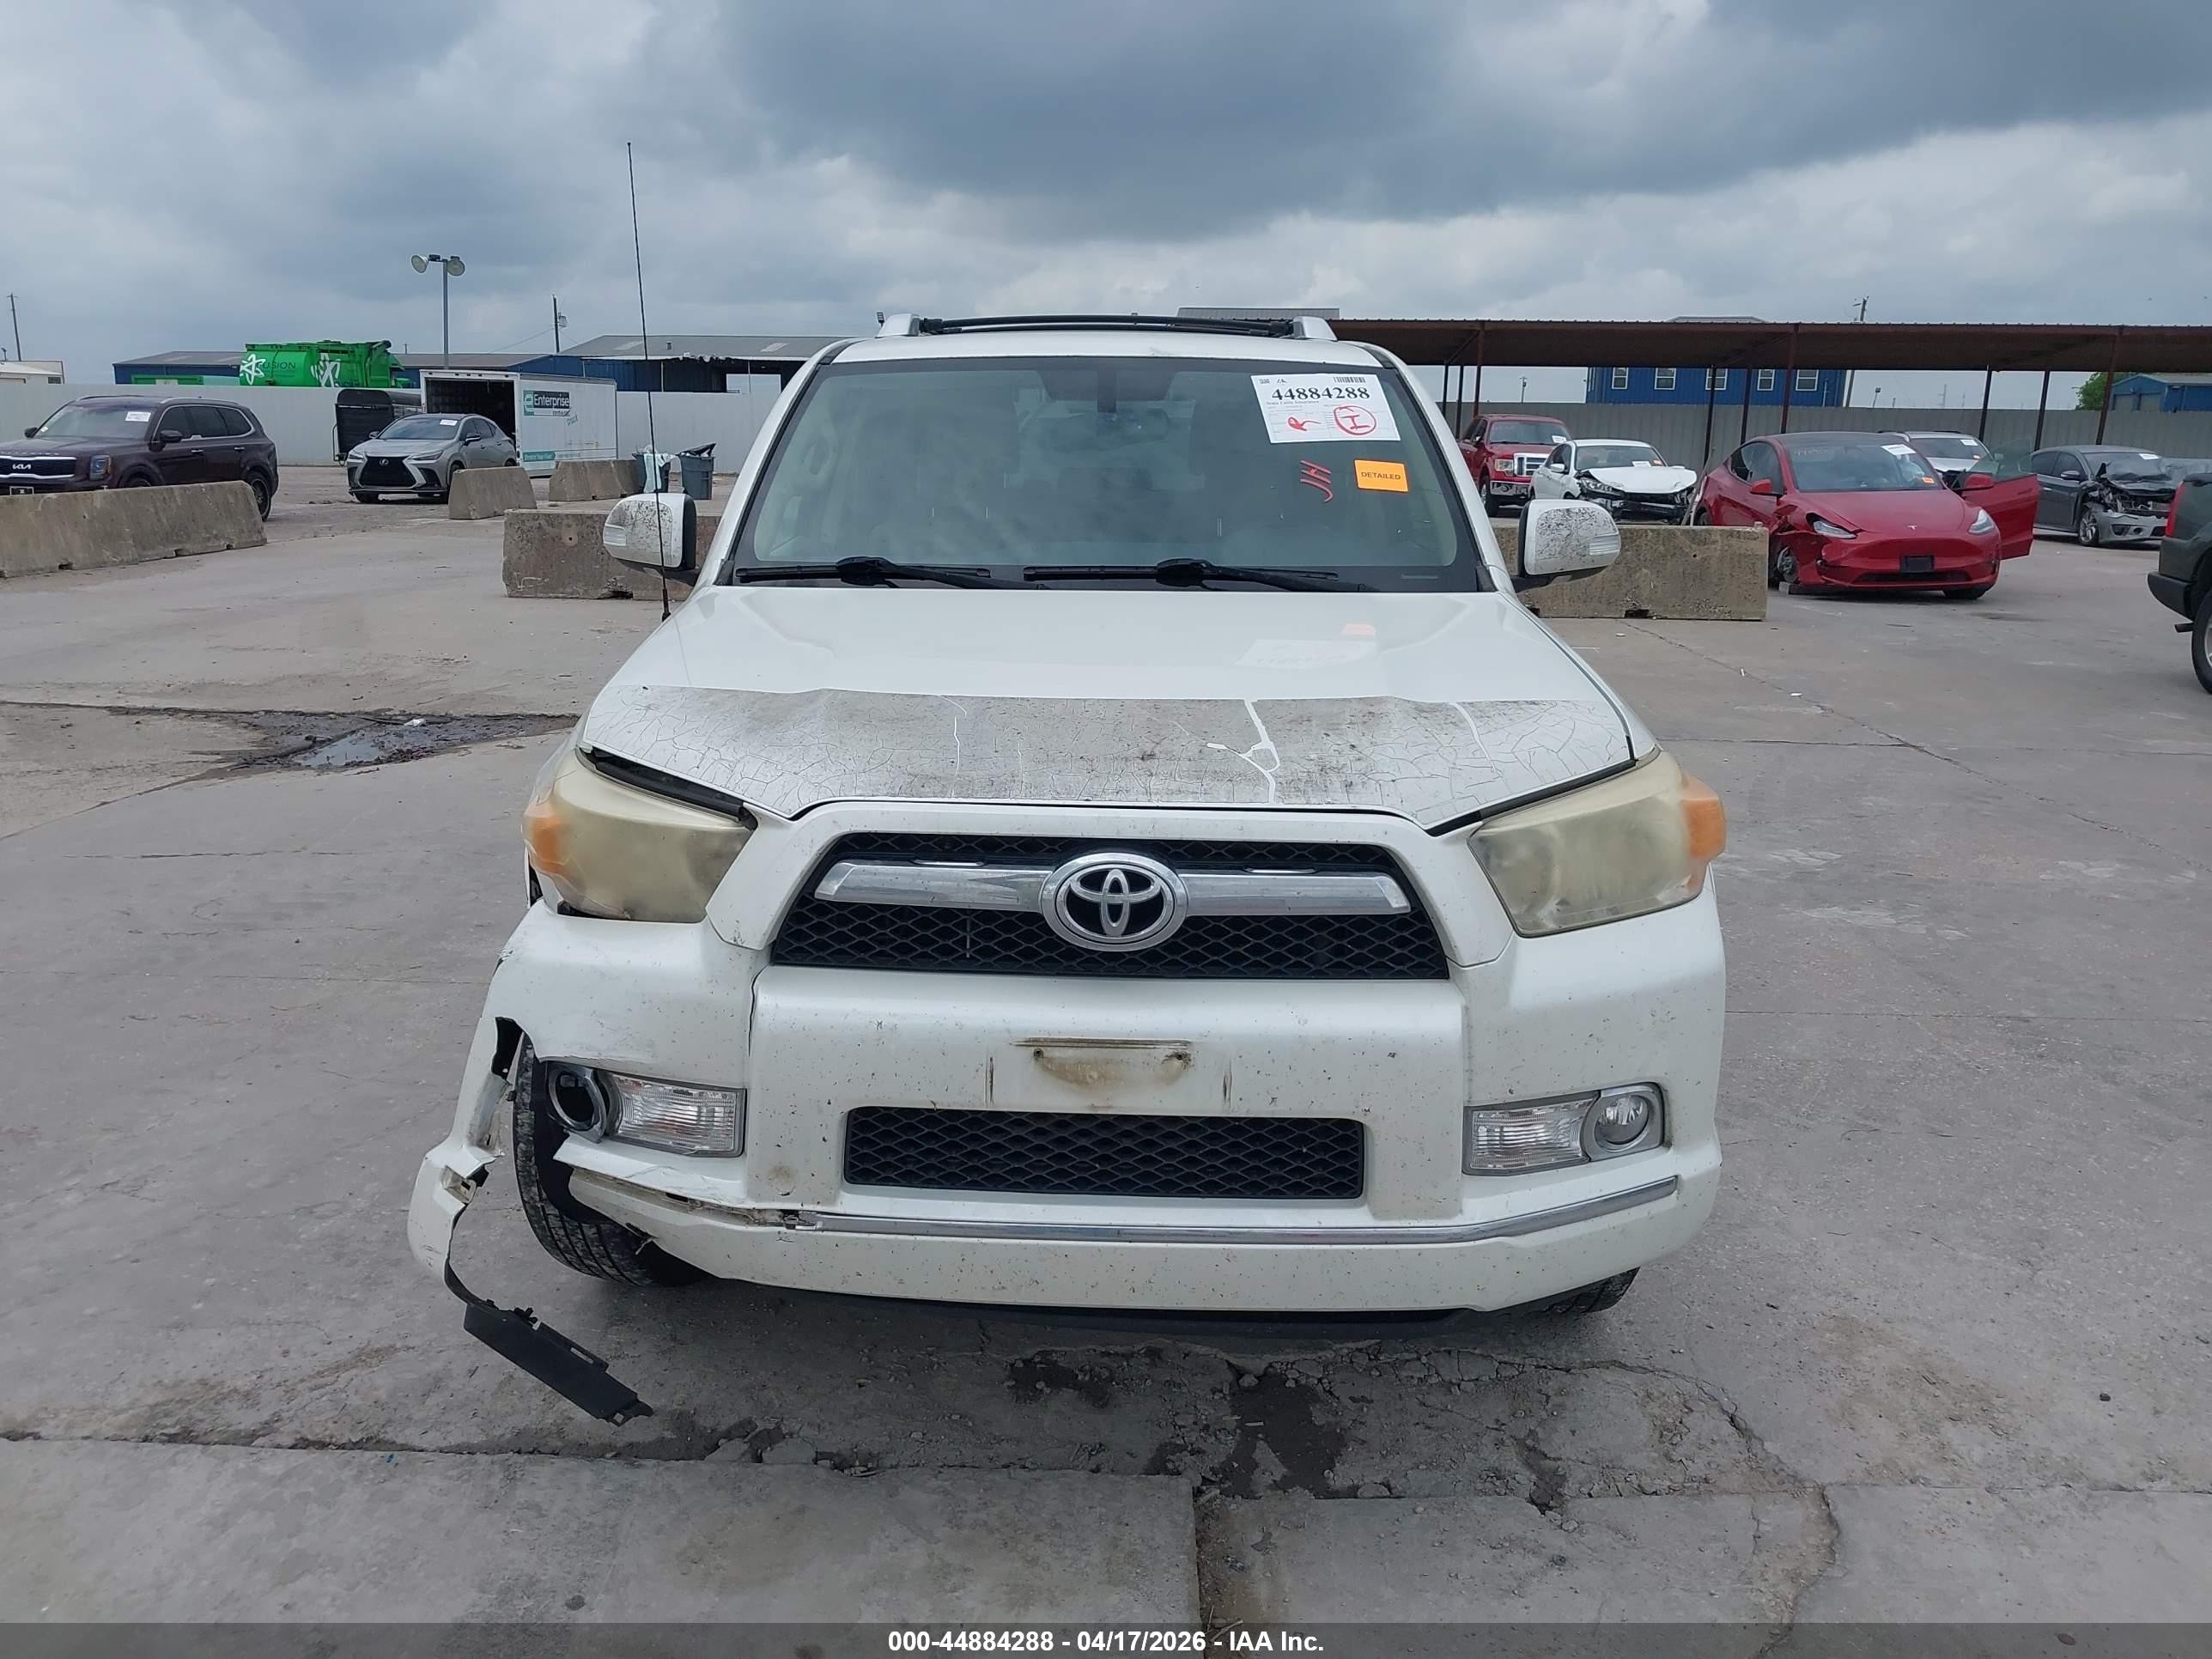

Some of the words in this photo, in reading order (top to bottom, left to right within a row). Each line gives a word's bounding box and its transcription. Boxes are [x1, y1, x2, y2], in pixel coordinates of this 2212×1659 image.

[260, 362, 296, 371] USION
[1272, 386, 1370, 401] 44884288
[534, 393, 570, 410] Enterprise
[1360, 471, 1401, 480] DETAILED
